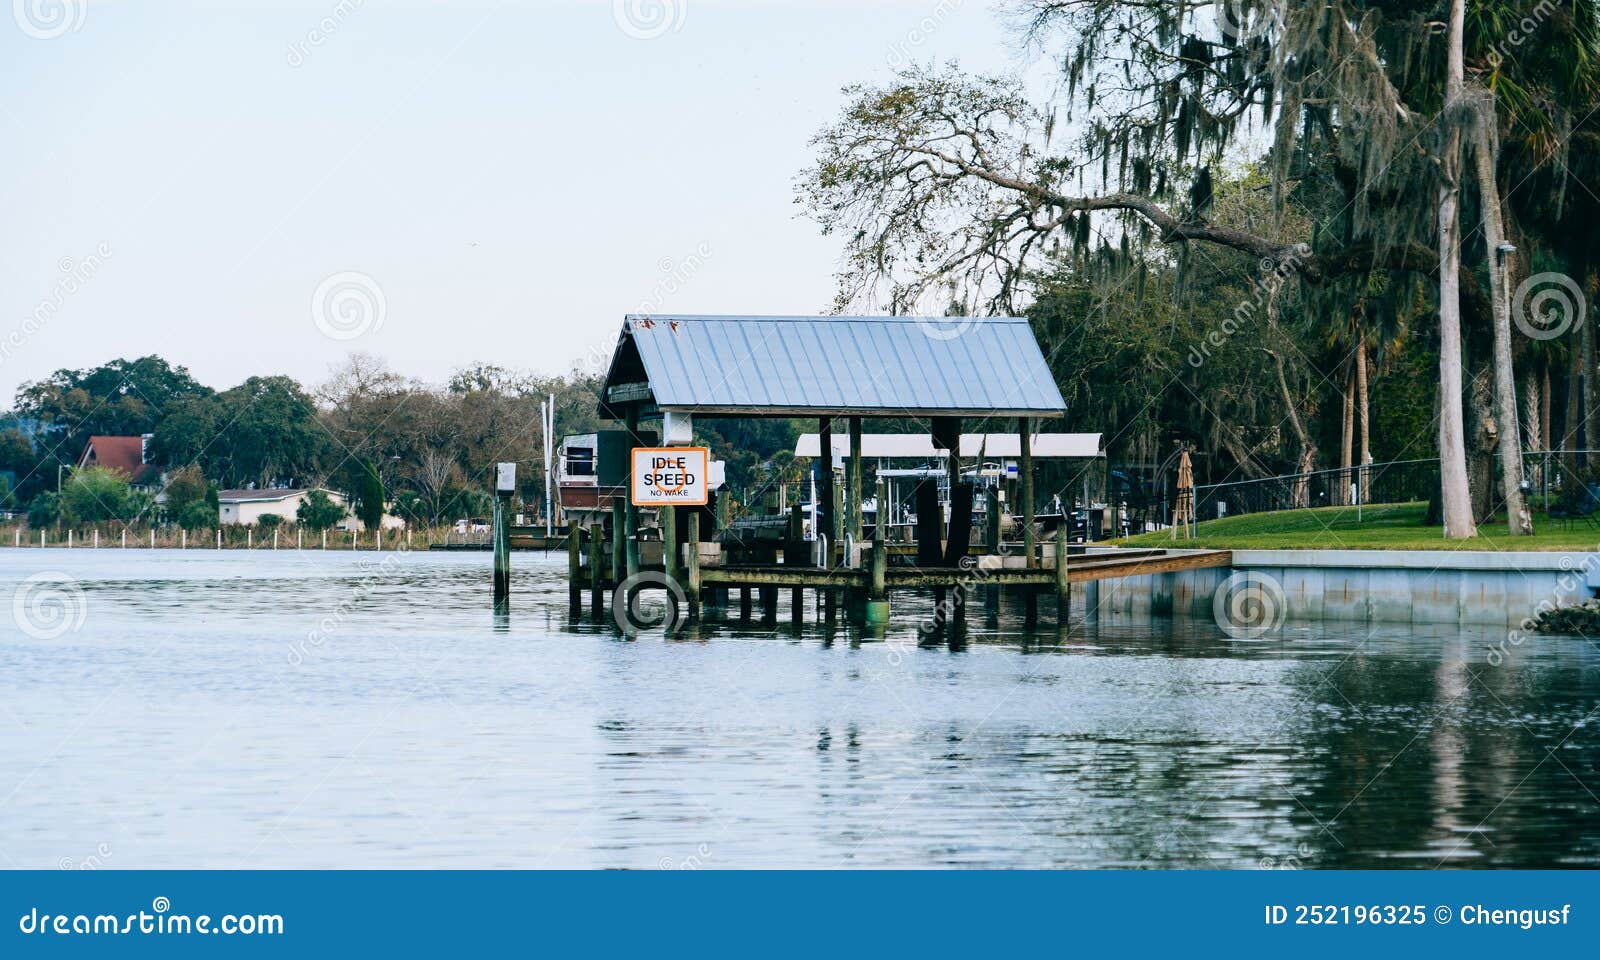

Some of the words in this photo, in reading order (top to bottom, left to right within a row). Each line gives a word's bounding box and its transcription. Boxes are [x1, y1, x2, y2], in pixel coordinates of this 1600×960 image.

[652, 457, 686, 469] IDLE
[643, 473, 695, 486] SPEED
[650, 489, 662, 497] NO
[665, 489, 689, 497] WAKE
